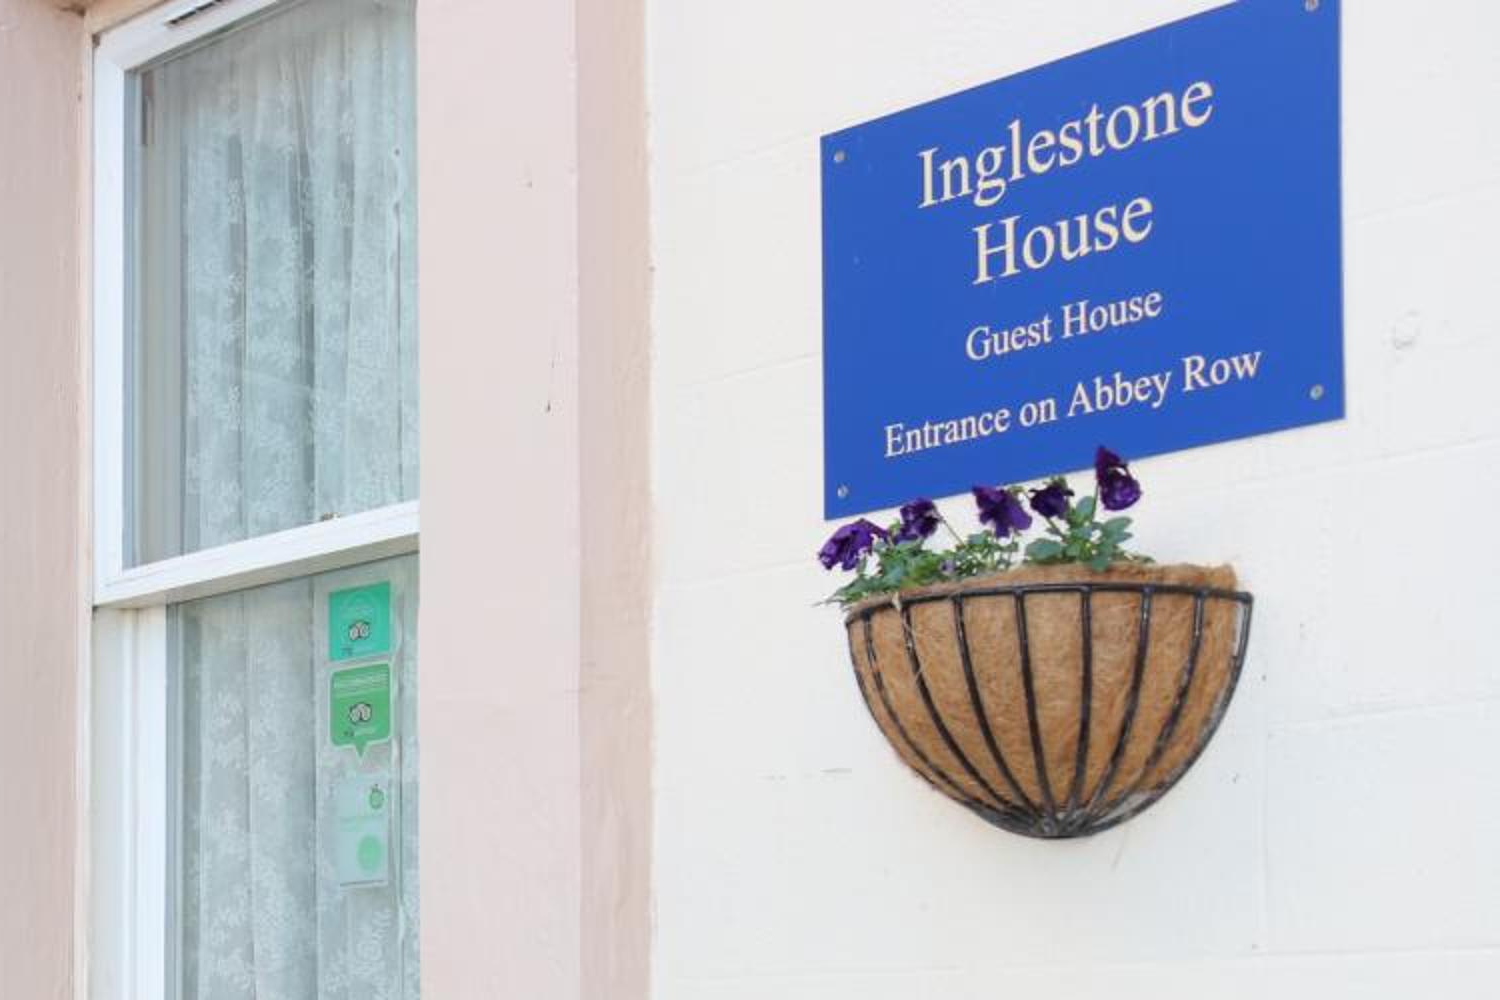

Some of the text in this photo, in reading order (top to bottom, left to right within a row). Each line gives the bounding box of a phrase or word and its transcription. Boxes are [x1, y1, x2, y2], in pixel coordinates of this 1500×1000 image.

[917, 80, 1214, 208] Inglestone
[971, 196, 1154, 285] House
[964, 291, 1163, 362] Guest House
[883, 350, 1263, 458] Entrance on Abbey Row
